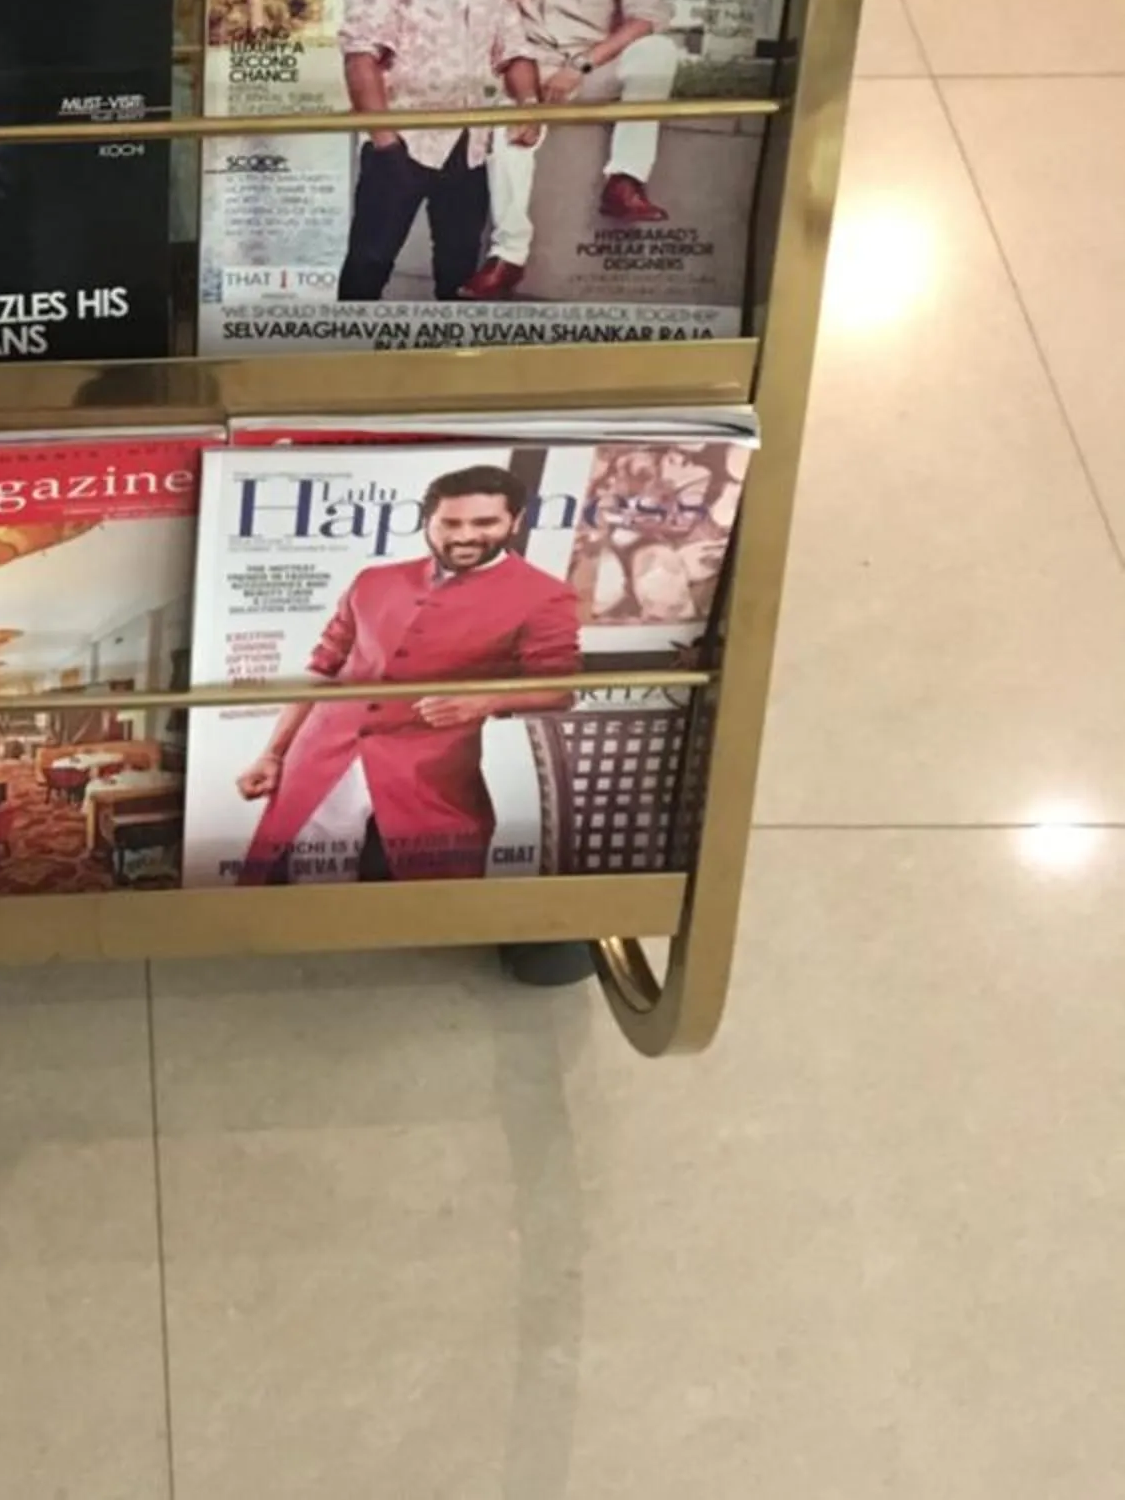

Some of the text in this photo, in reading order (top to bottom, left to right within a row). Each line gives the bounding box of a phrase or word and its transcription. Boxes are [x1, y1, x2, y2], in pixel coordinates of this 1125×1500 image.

[229, 55, 299, 69] SECOND
[229, 69, 300, 83] CHANCE
[225, 272, 338, 287] THAT TOO
[77, 287, 131, 320] HIS
[222, 321, 411, 339] SELVARAGHAVAN
[417, 323, 466, 340] AND
[469, 323, 546, 342] YUVAN
[550, 324, 654, 343] SHANKAR
